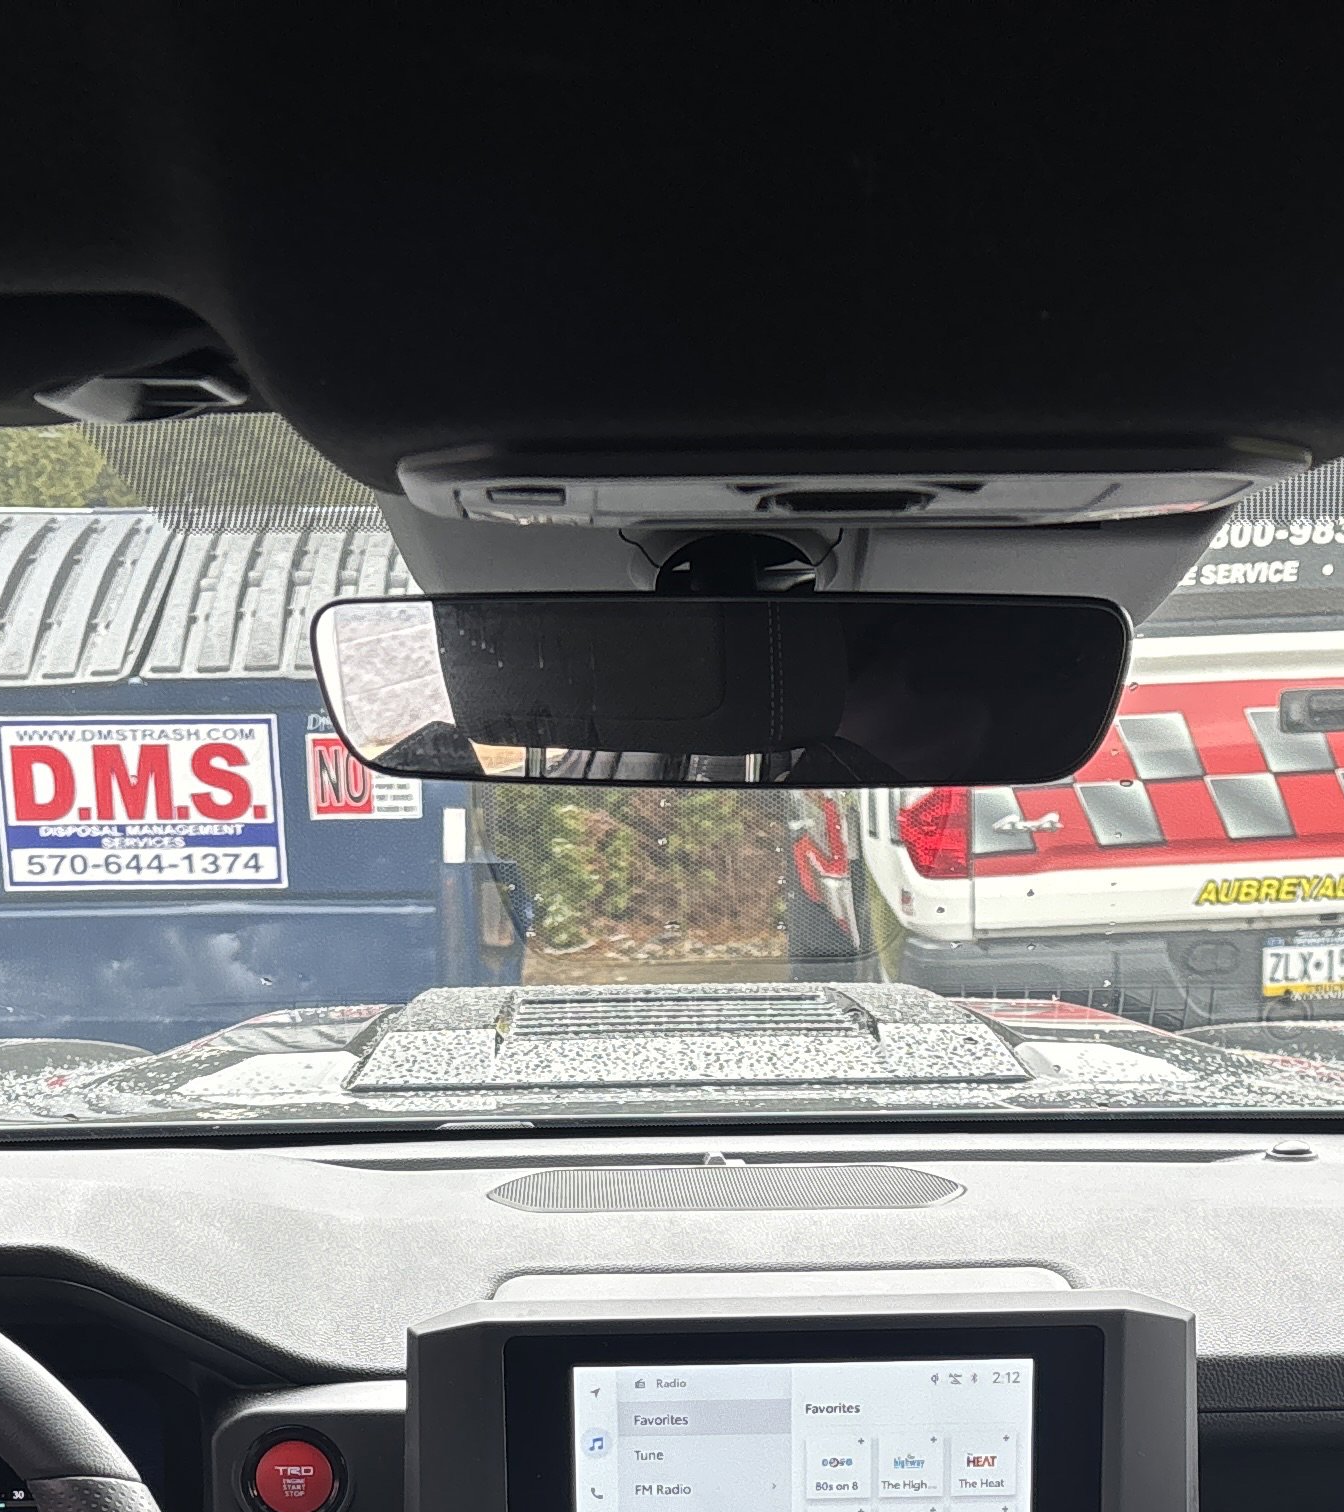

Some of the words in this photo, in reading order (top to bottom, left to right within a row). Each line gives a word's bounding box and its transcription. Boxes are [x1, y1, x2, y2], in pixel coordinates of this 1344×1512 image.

[1199, 560, 1300, 585] SERVICE
[15, 728, 256, 742] WWW.DMSTRASH.COM
[9, 743, 268, 821] D.M.S.
[38, 825, 125, 838] DISPOSAL
[125, 823, 245, 837] MANAGEMENT
[101, 837, 186, 849] SERVICES
[27, 853, 264, 876] 570-644-1374
[655, 1378, 687, 1389] Radio
[805, 1403, 861, 1415] Favorites
[633, 1414, 689, 1426] Favorites
[633, 1450, 664, 1461] Tune
[274, 1466, 314, 1476] TRD
[634, 1484, 653, 1495] FM
[656, 1483, 692, 1495] Radio
[881, 1480, 901, 1490] The
[959, 1479, 979, 1489] The
[980, 1478, 1005, 1489] Heat
